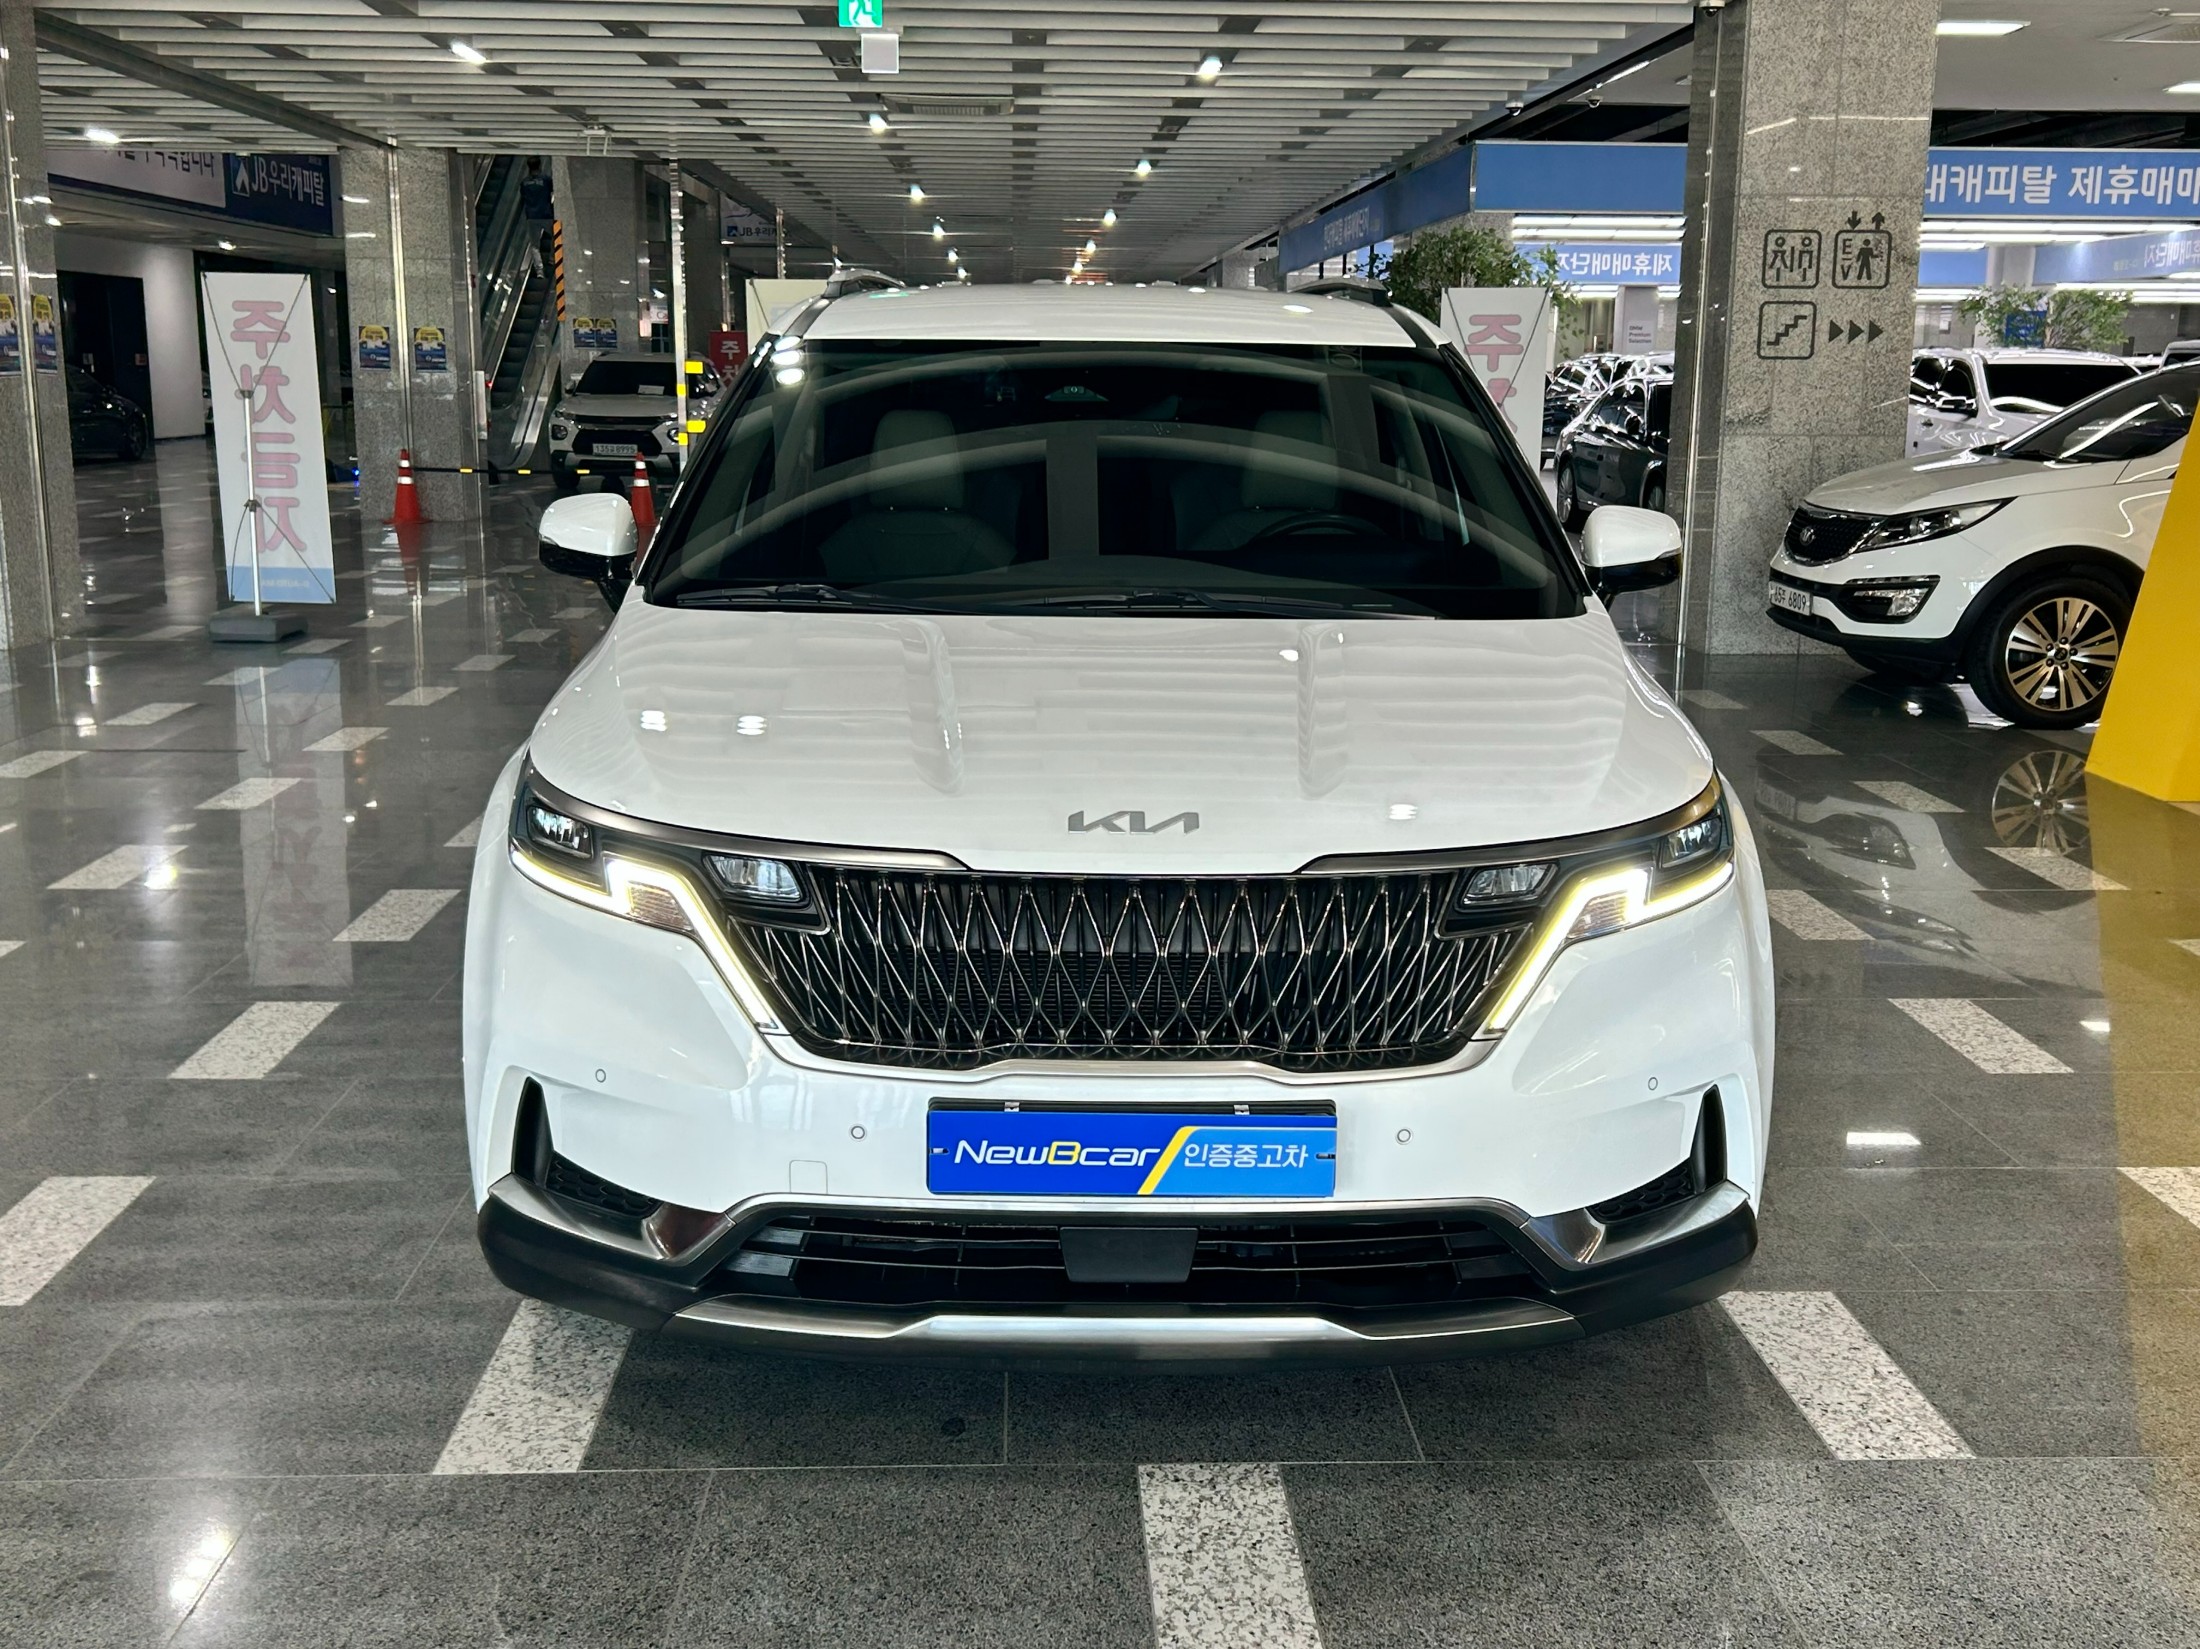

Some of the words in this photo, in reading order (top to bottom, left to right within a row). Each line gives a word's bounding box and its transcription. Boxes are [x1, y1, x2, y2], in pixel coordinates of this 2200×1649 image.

[251, 155, 325, 207] JB우리캐피탈
[1068, 810, 1200, 834] KIA
[954, 1139, 1160, 1167] NewBcar
[1183, 1142, 1308, 1169] 인증중고차
